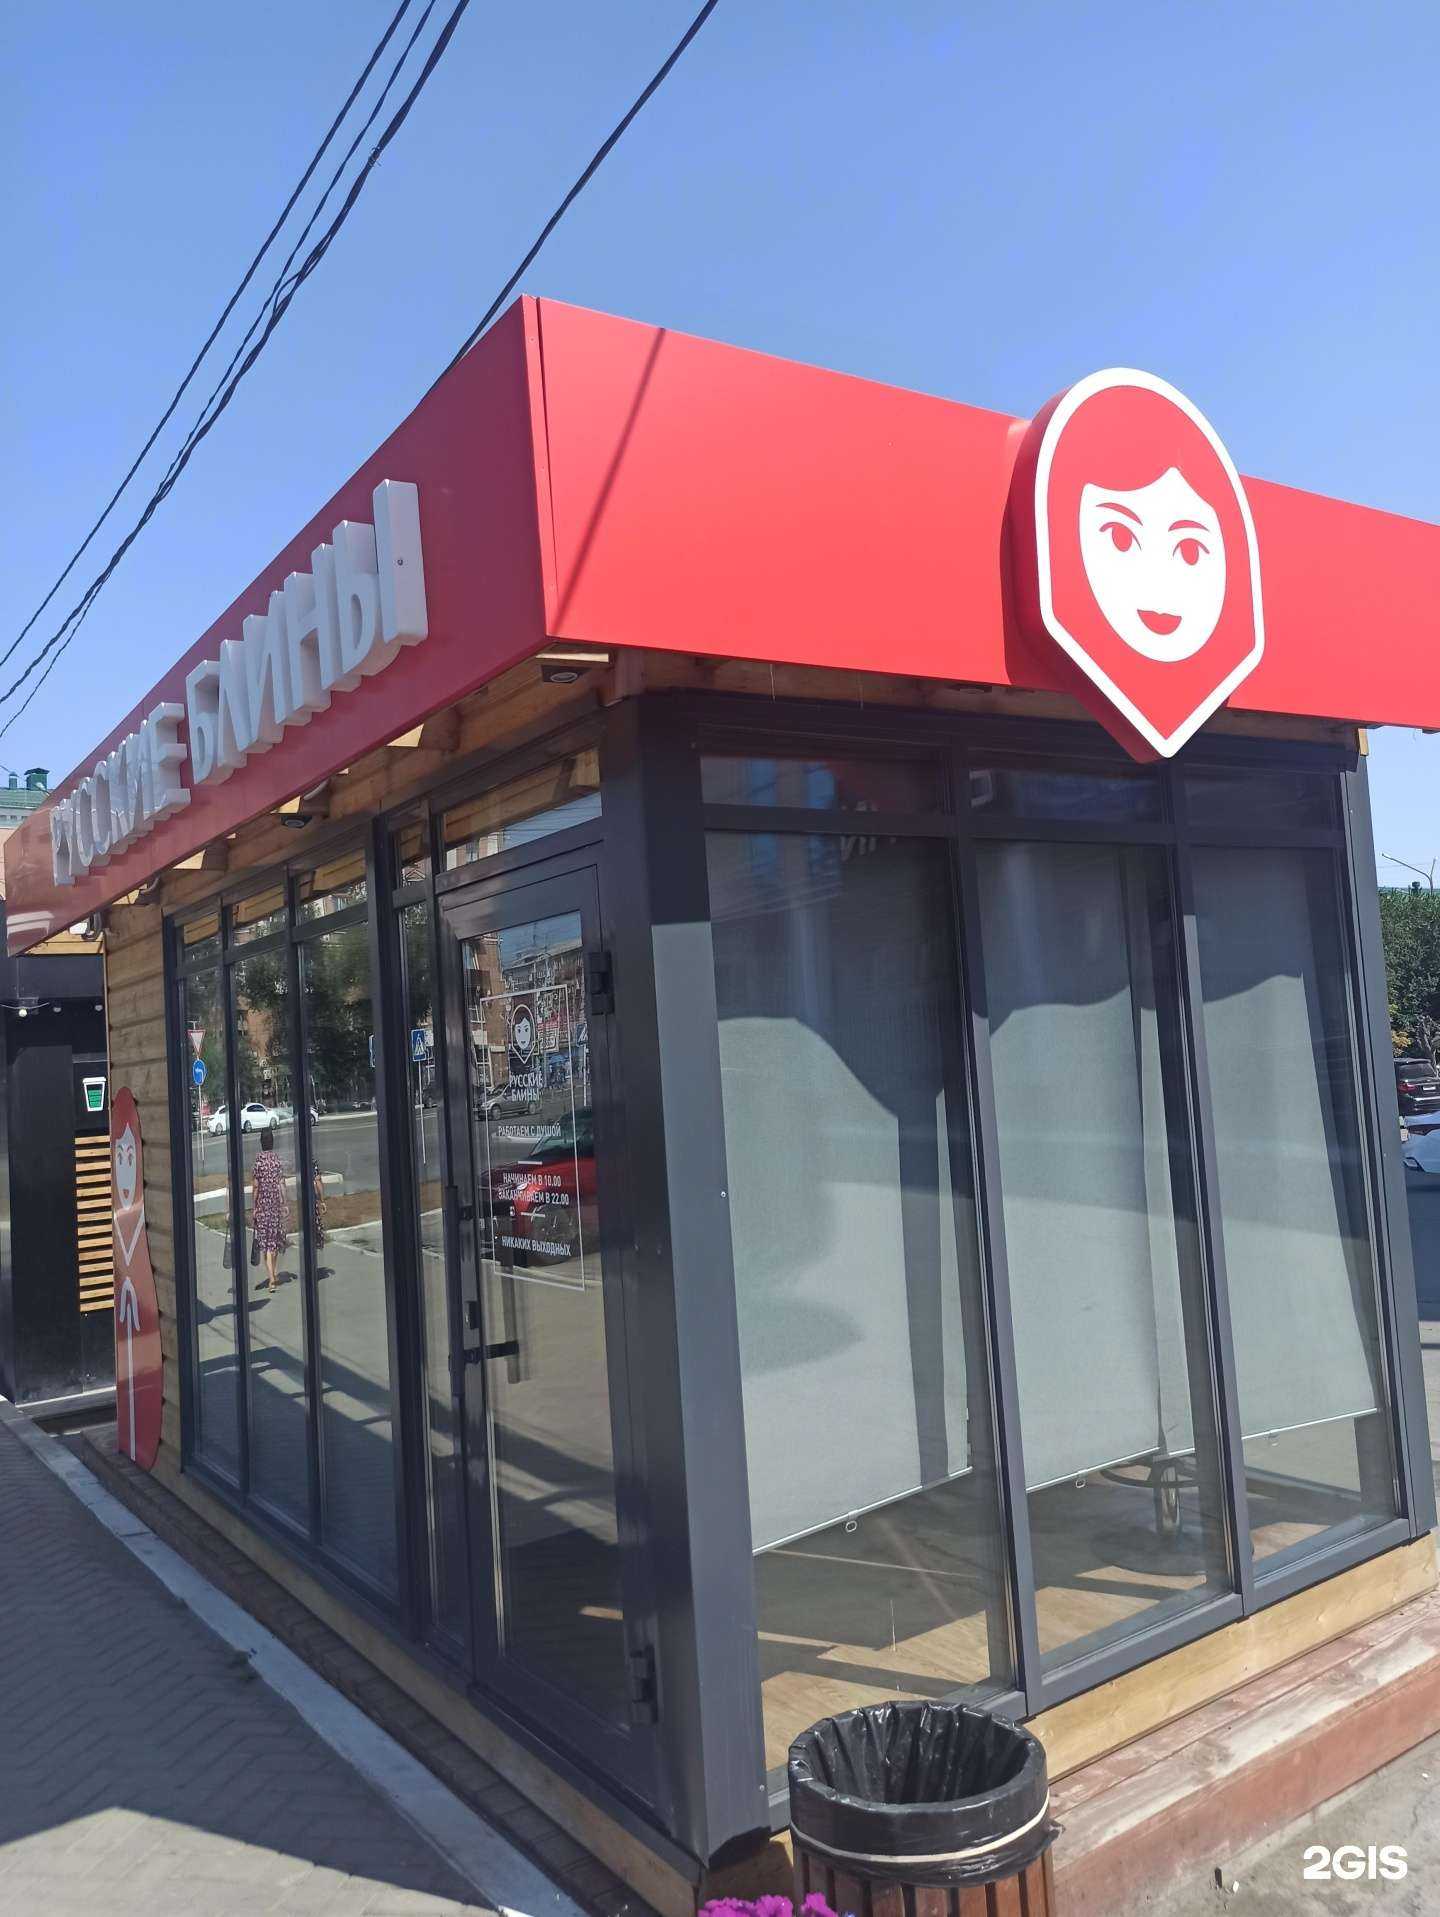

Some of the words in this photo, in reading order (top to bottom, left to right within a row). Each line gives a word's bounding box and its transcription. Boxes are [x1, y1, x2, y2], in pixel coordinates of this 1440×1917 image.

[186, 478, 429, 785] БЛИНЫ
[509, 1071, 543, 1088] РУССКИЕ
[511, 1088, 541, 1102] БЛИНЫ
[498, 1125, 528, 1137] РАБОТАЕМ
[537, 1123, 561, 1138] ДУШОЙ
[503, 1173, 537, 1185] НАЧИНАЕМ
[544, 1175, 562, 1187] 10.00
[551, 1193, 569, 1205] 22.00
[502, 1236, 531, 1250] НИКАКИХ
[532, 1240, 571, 1256] ВЫХОДНЫХ
